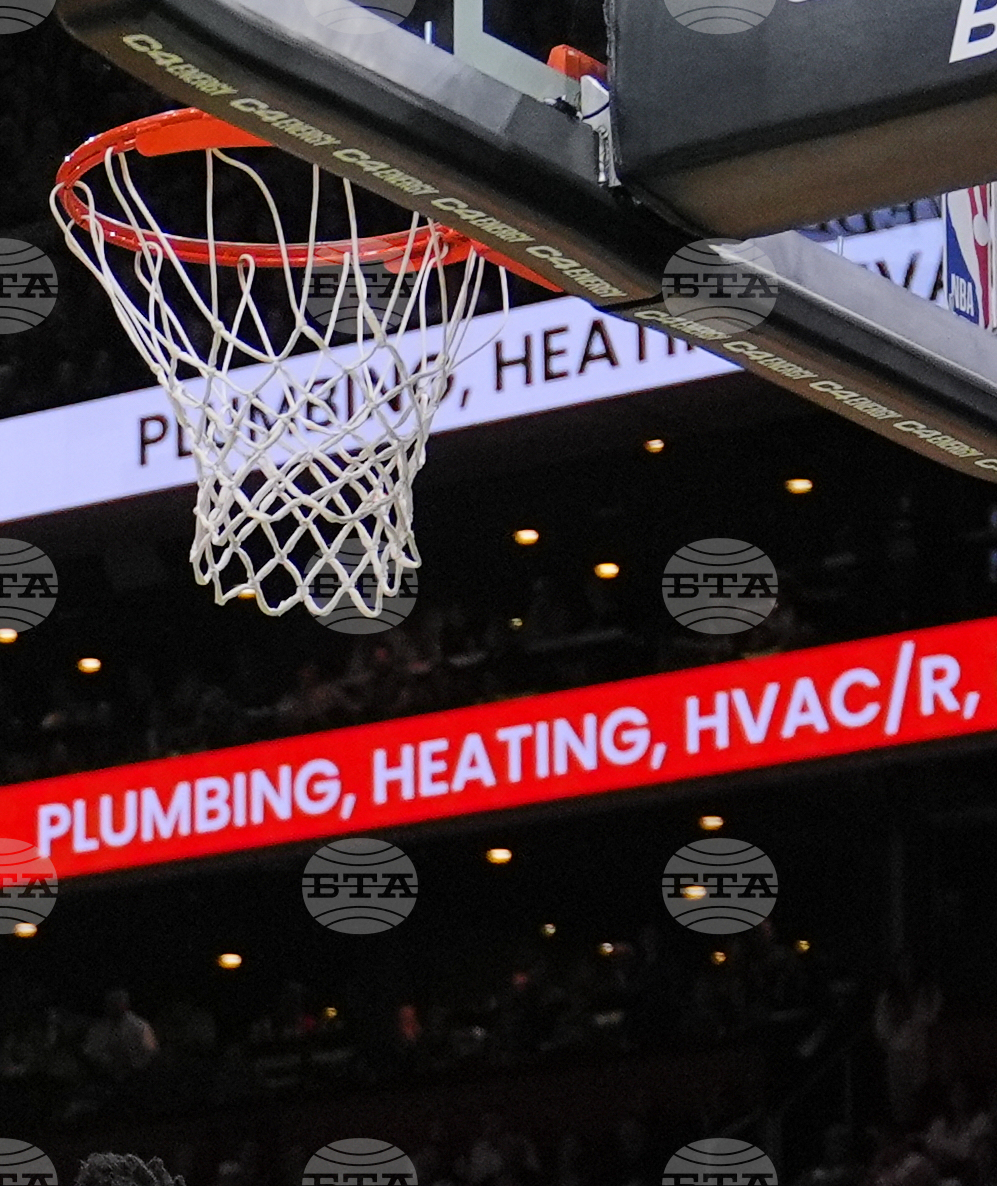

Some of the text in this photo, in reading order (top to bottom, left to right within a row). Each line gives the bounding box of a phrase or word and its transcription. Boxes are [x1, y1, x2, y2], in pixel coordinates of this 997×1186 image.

[951, 273, 975, 317] NBA
[37, 640, 980, 859] PLUMBING, HEATING, HVAC/R,
